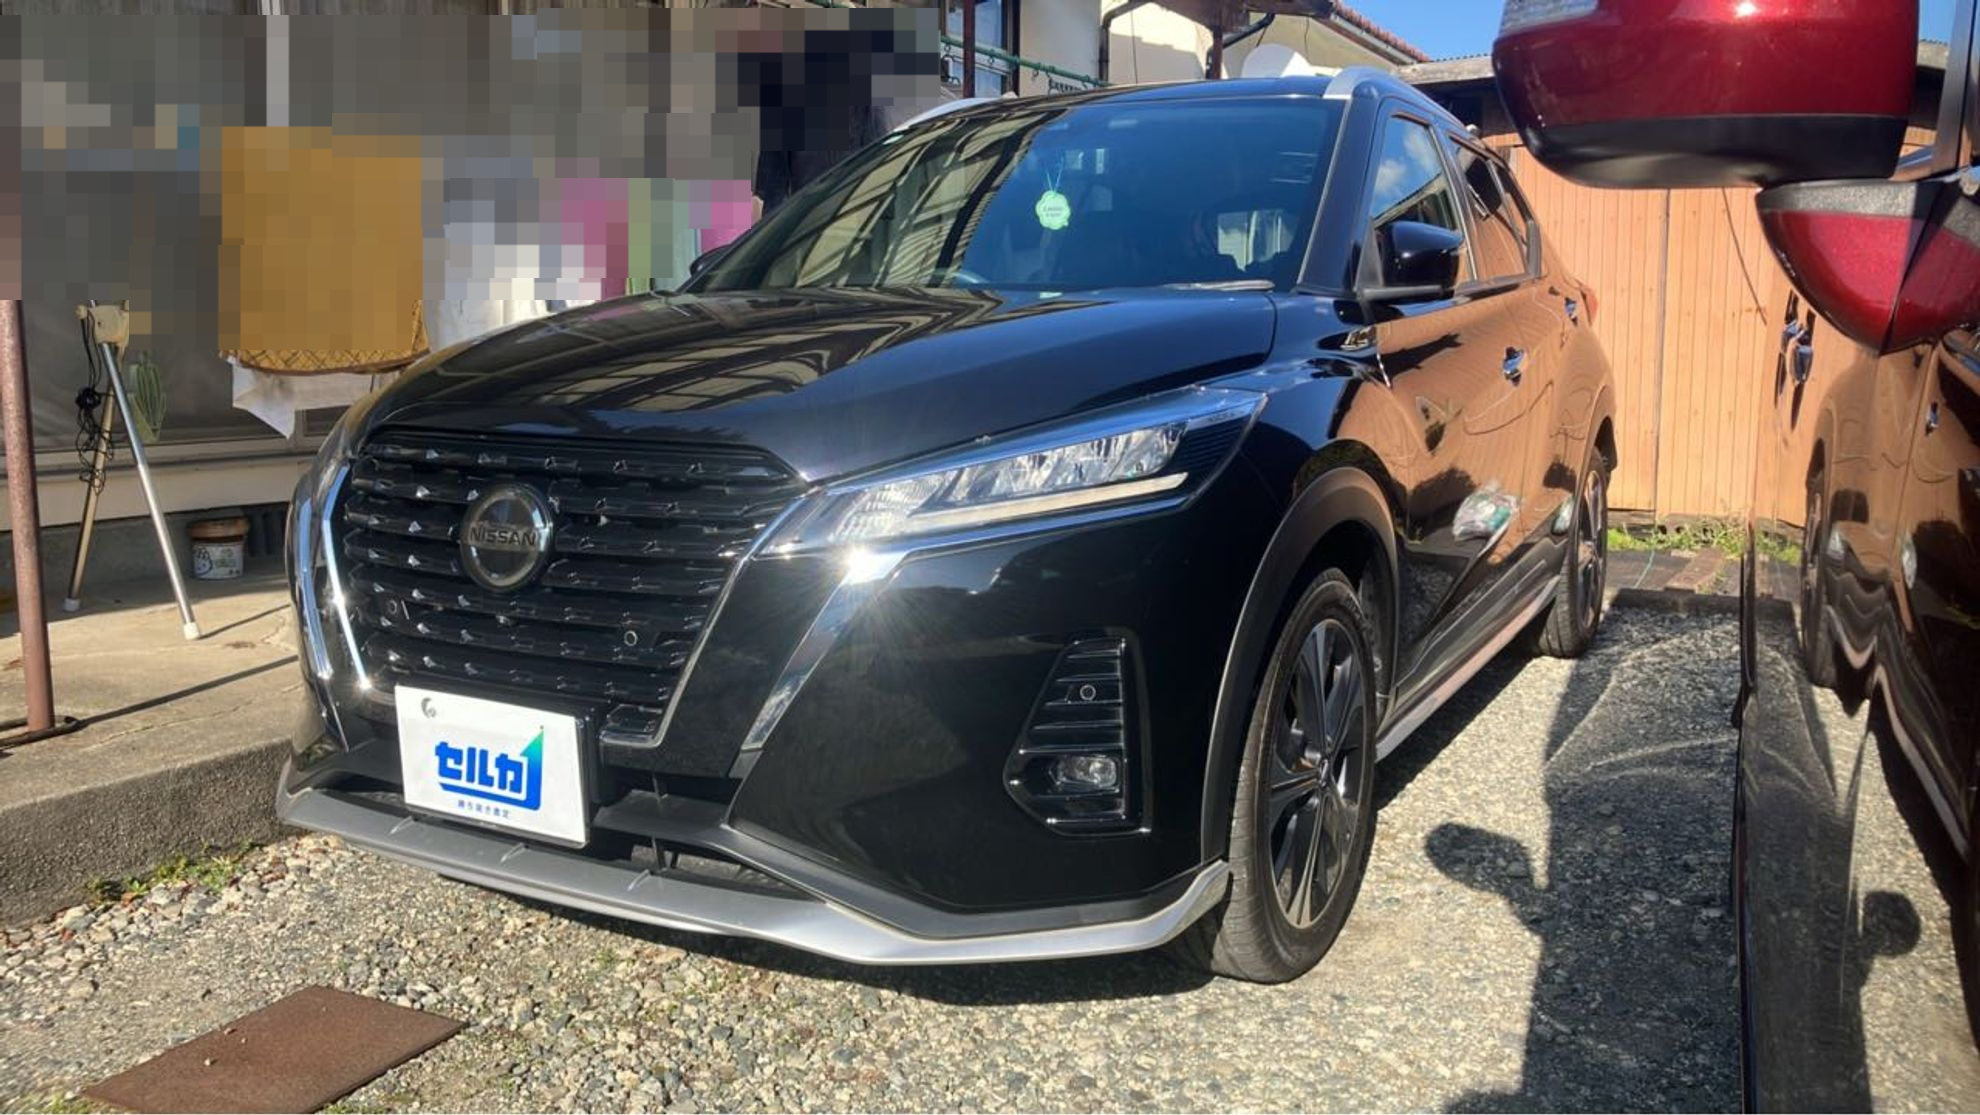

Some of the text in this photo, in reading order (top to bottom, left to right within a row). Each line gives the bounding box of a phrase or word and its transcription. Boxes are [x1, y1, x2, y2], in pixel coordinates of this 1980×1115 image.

[470, 527, 537, 547] NISSAN
[435, 741, 523, 794] セルカ
